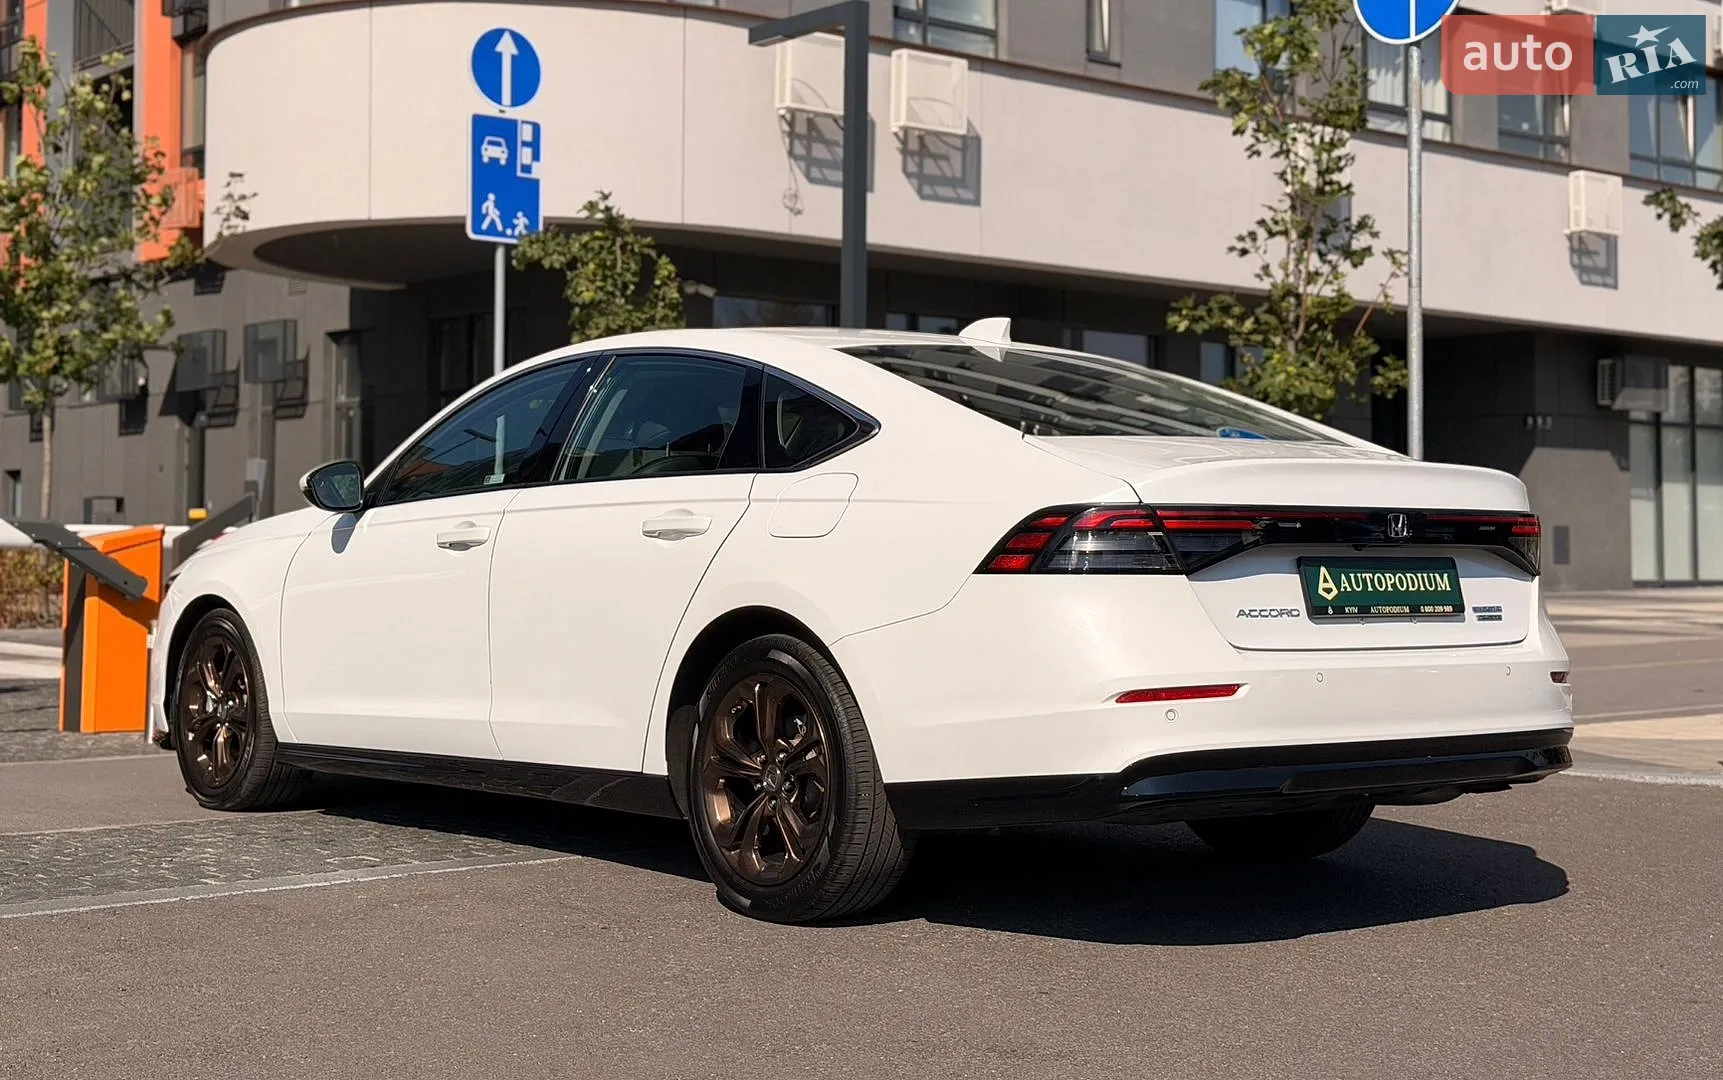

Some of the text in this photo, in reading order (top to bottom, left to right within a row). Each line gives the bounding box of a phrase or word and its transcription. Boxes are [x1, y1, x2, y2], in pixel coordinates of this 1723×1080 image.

[1340, 572, 1452, 592] AUTOPODIUM
[1236, 608, 1301, 619] ACCORD
[1344, 605, 1358, 613] KYIV
[1370, 605, 1410, 613] AUTOPODIUM
